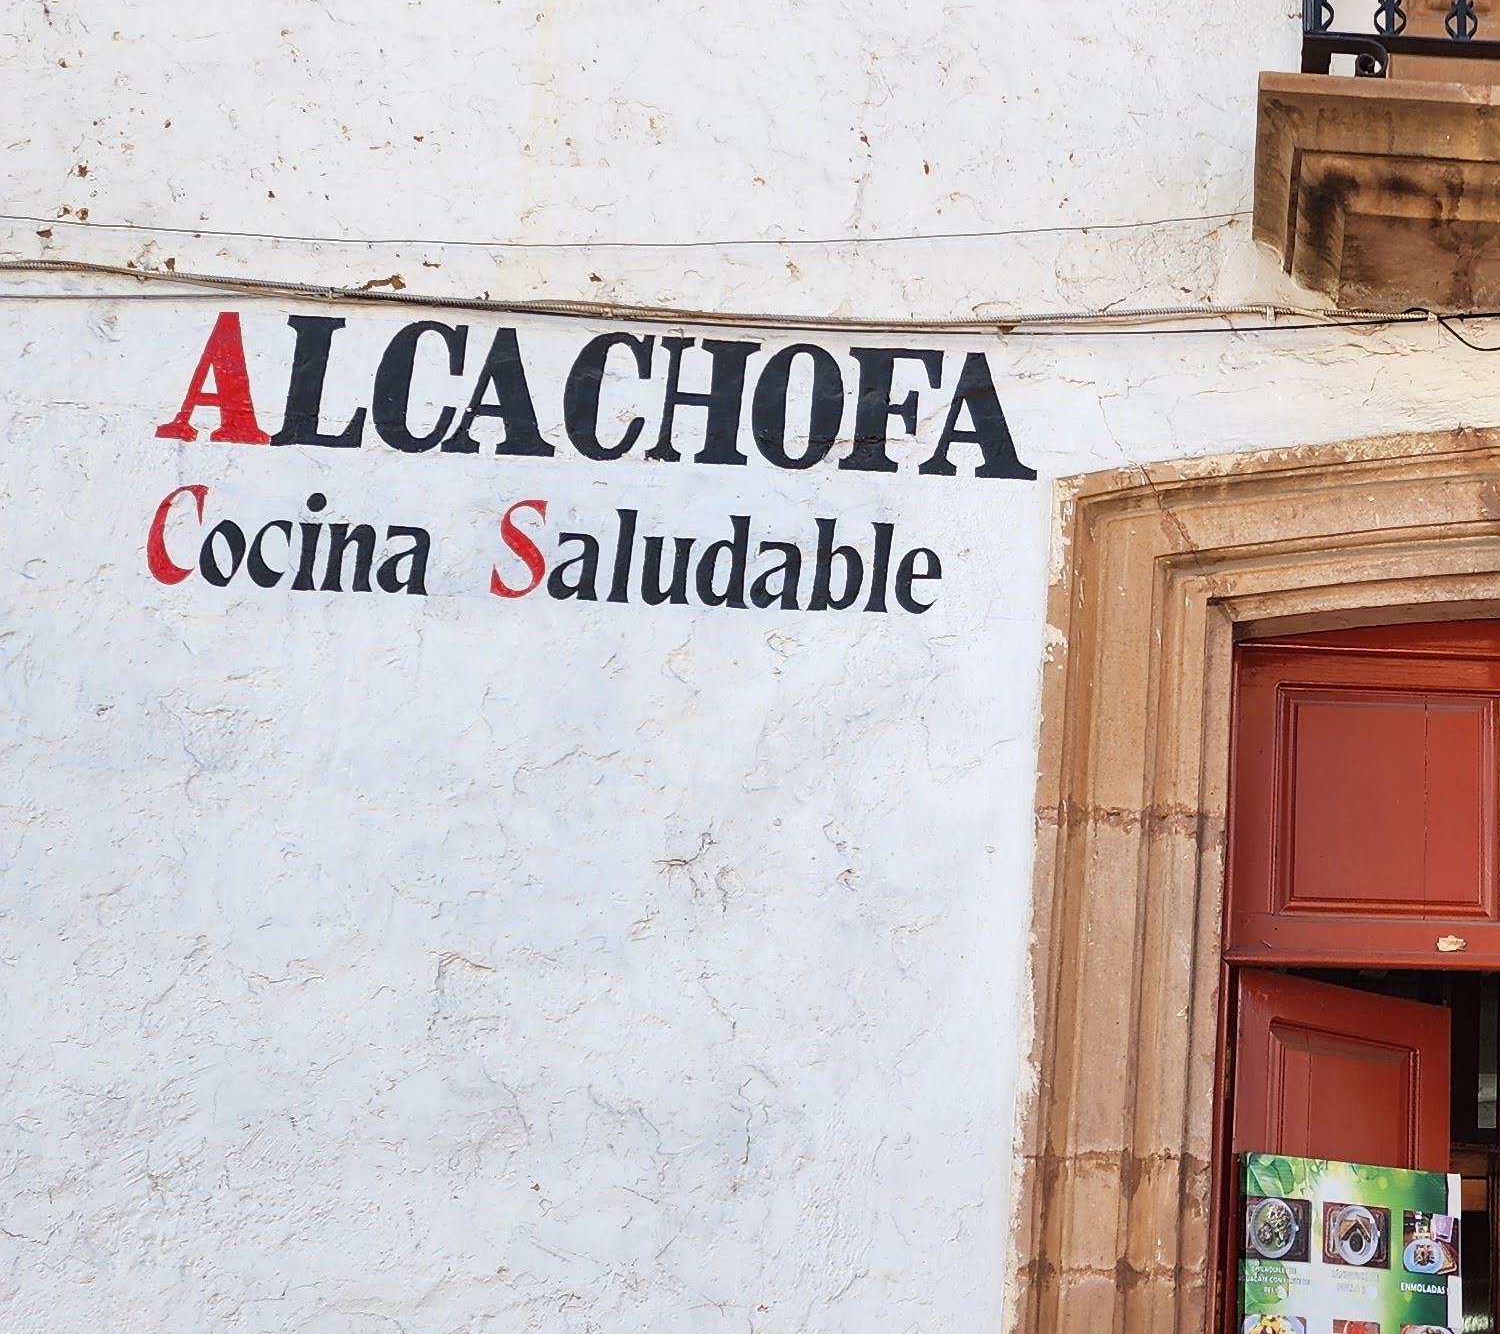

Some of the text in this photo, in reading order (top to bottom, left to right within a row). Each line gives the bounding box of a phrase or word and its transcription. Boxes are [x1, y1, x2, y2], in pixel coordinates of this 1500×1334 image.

[154, 311, 1038, 481] ALCACHOFA
[147, 483, 943, 615] Cocina Saludable
[1400, 1282, 1446, 1295] ENMOLADAS
